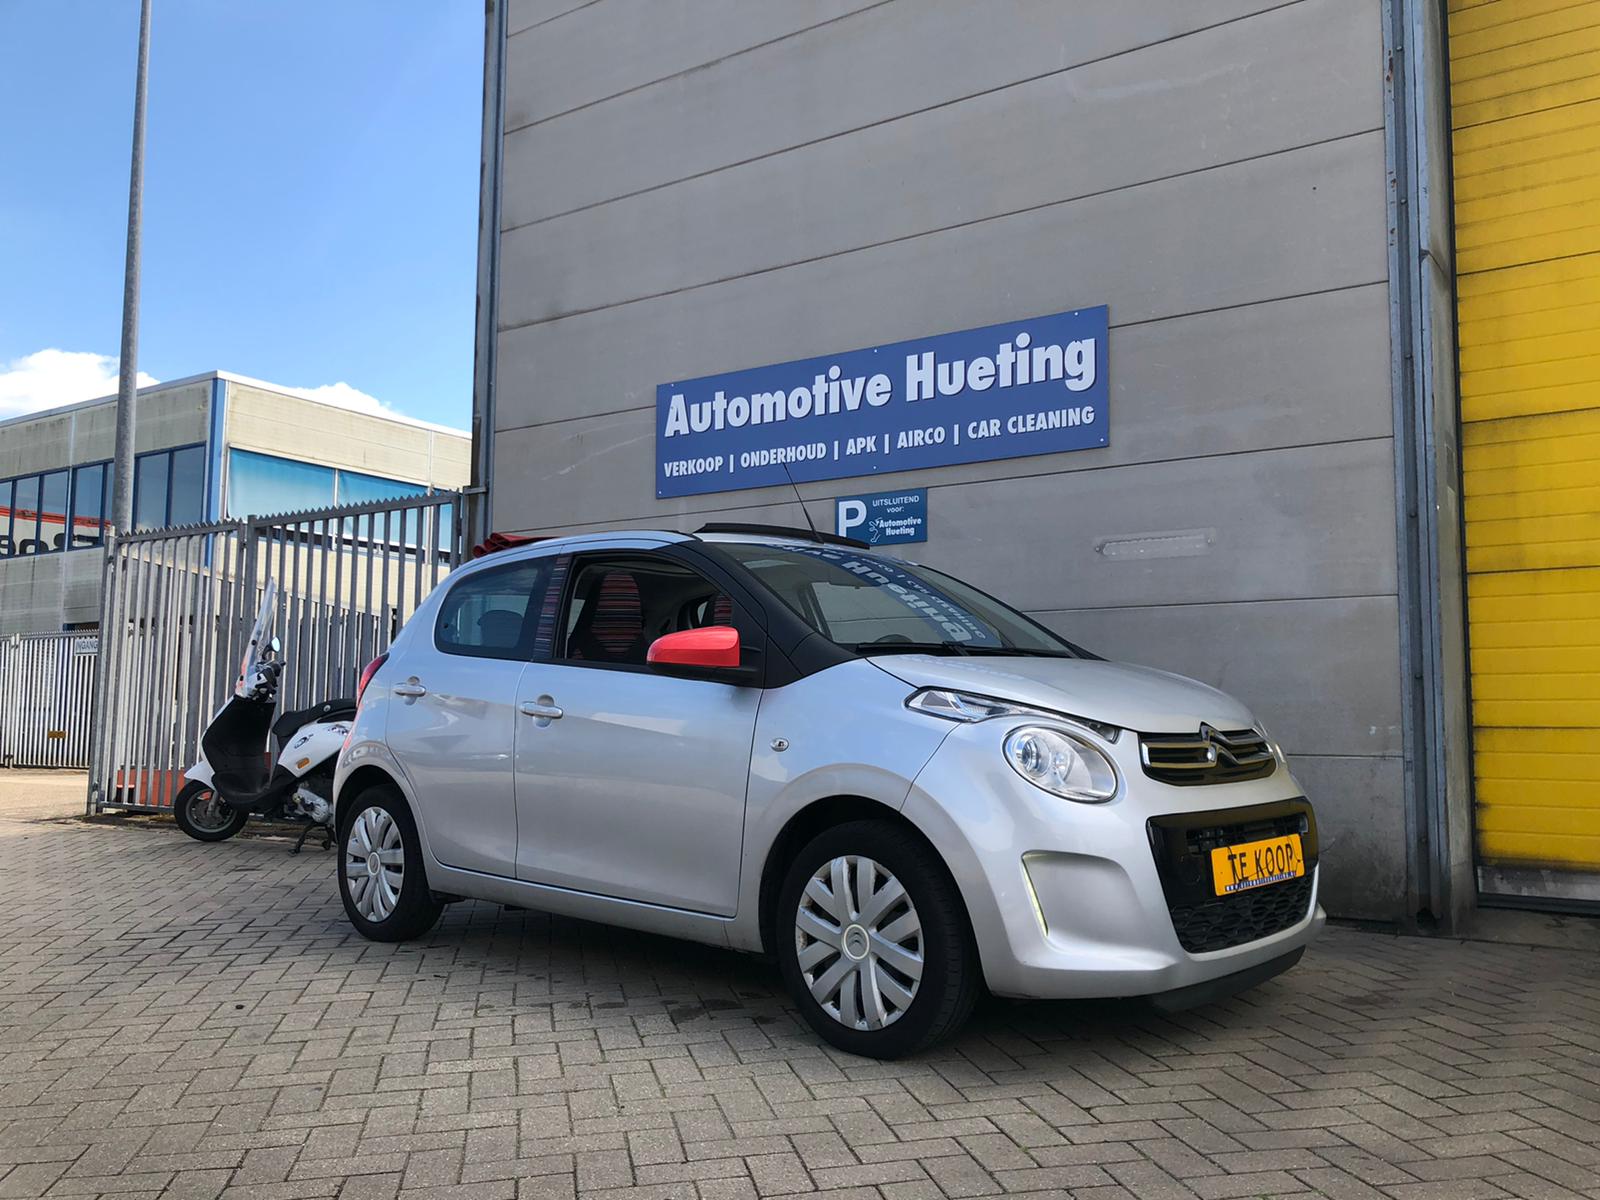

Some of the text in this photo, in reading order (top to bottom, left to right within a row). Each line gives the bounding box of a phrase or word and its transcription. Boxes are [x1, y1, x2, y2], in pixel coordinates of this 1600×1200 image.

[664, 332, 1096, 437] Automotive Hueting
[664, 406, 1095, 478] VERKOOP ONDERHOUD APK AIRCO CAR CLEANING
[838, 500, 867, 538] P
[872, 495, 920, 507] UITSLUITEND
[879, 516, 922, 528] Automotive
[885, 526, 915, 536] Hueting
[1228, 852, 1247, 884] TE
[1255, 843, 1293, 878] KOOP
